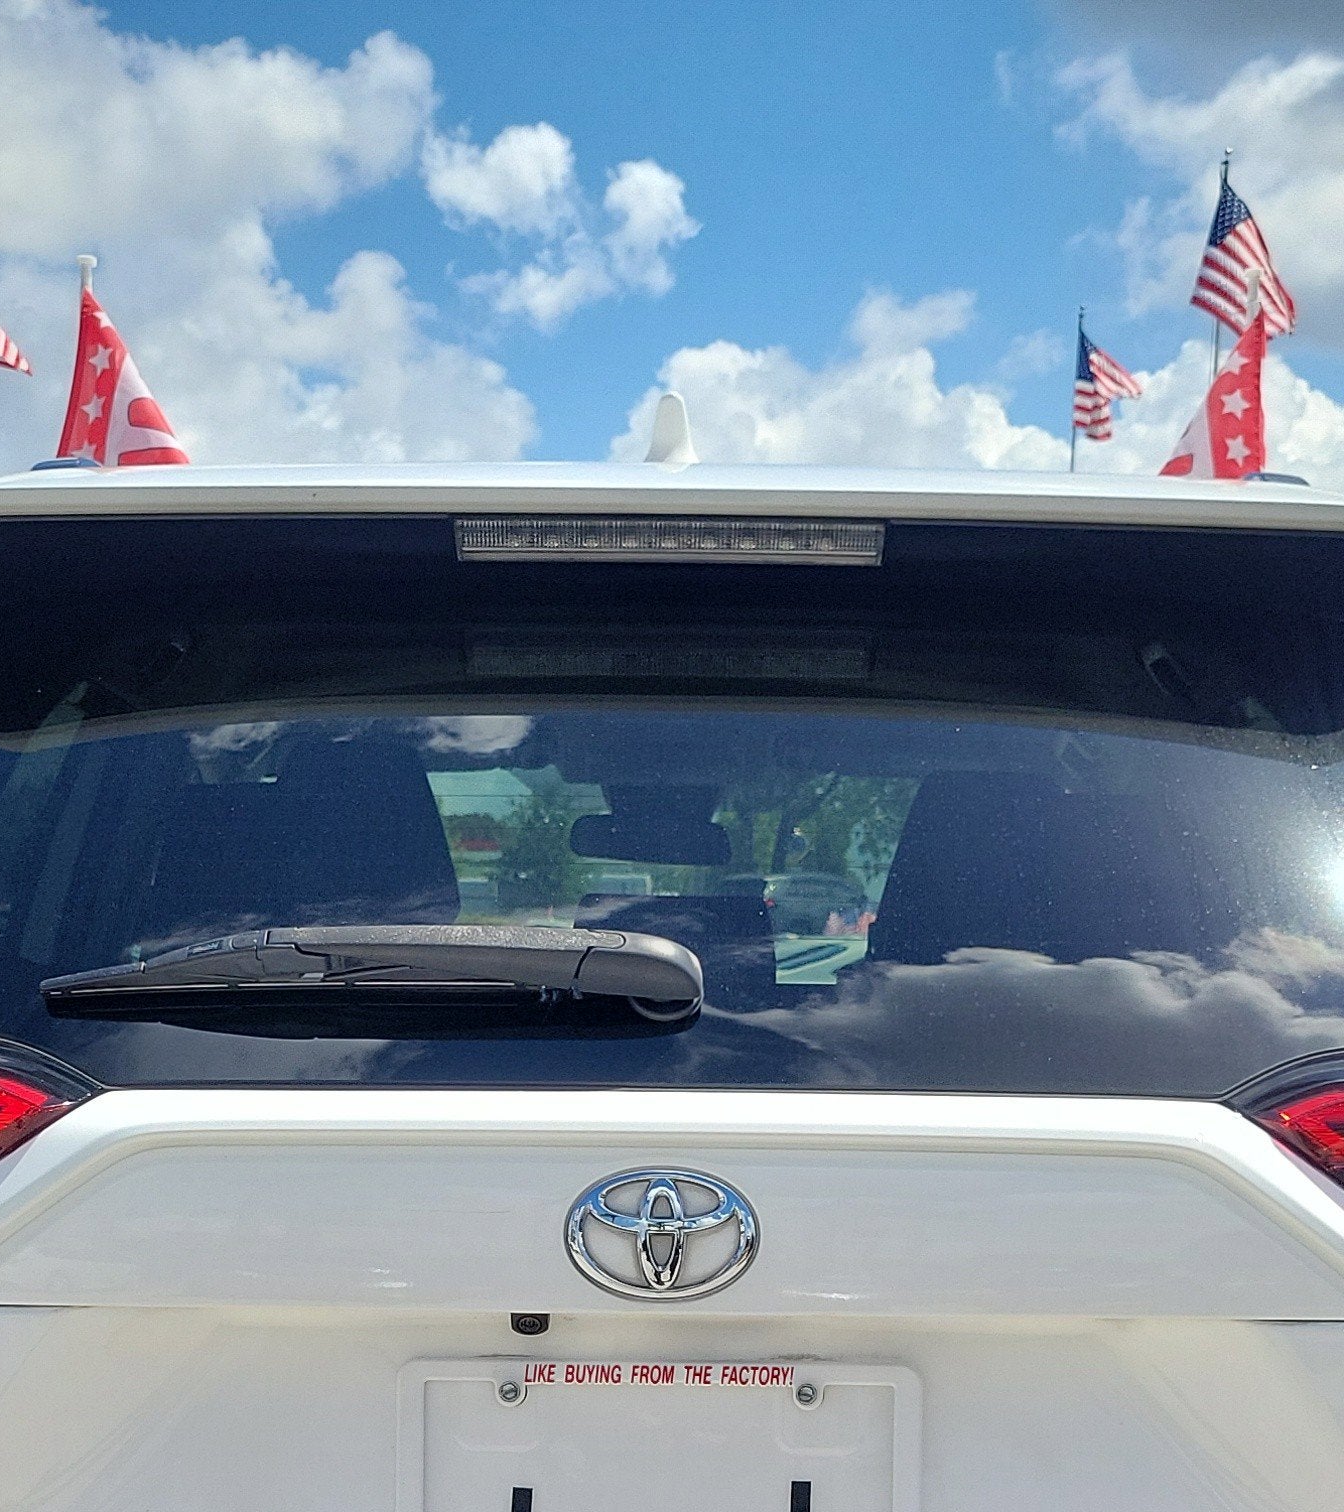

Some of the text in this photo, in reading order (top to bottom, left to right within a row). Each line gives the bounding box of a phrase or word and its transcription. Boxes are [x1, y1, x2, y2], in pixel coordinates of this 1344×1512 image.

[524, 1364, 794, 1387] LIKE BUYING FROM THE FACTORY!
